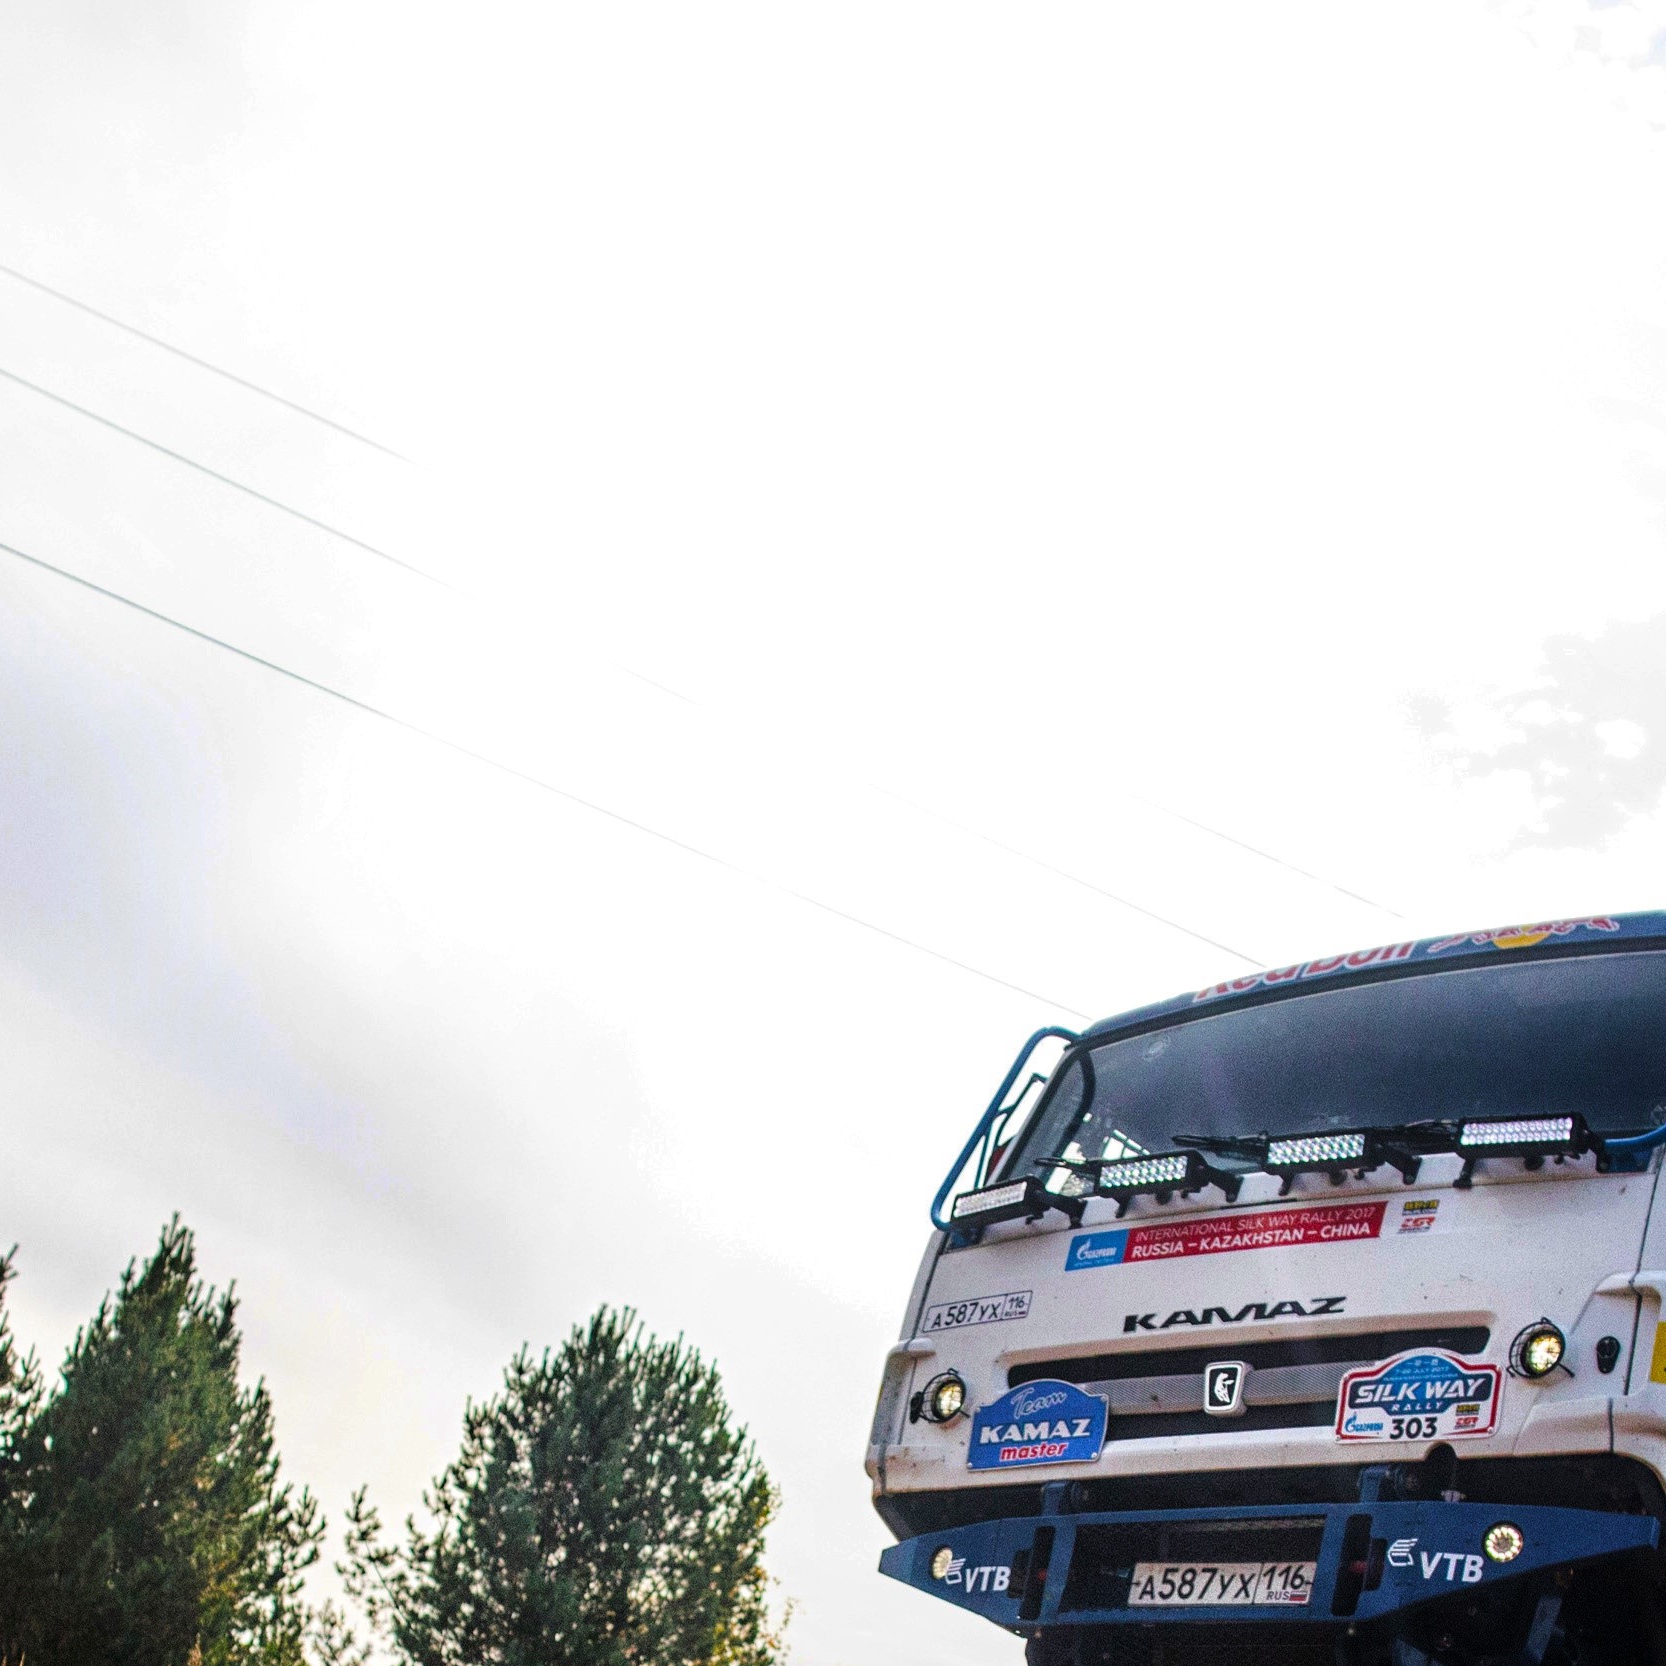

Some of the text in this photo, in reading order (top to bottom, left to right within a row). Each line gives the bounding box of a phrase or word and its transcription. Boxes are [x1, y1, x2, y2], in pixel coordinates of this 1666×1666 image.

[1136, 1206, 1376, 1243] INTERNATIONAL SILK WAY RALLY 2017
[1132, 1240, 1184, 1260] RUSSIA
[1199, 1228, 1305, 1252] KAZAKHSTAN
[1321, 1222, 1371, 1240] CHINA
[1008, 1295, 1025, 1310] 116
[1123, 1296, 1347, 1333] KAMAZ
[1011, 1387, 1068, 1420] Team
[1355, 1378, 1486, 1404] SILK WAY
[1391, 1401, 1444, 1412] RALLY
[979, 1418, 1092, 1445] KAMAZ
[1389, 1416, 1438, 1440] 303
[999, 1441, 1070, 1462] master
[965, 1565, 1012, 1594] VTB
[1263, 1564, 1306, 1591] 116
[1419, 1551, 1485, 1583] VTB
[1266, 1590, 1290, 1601] RUS
